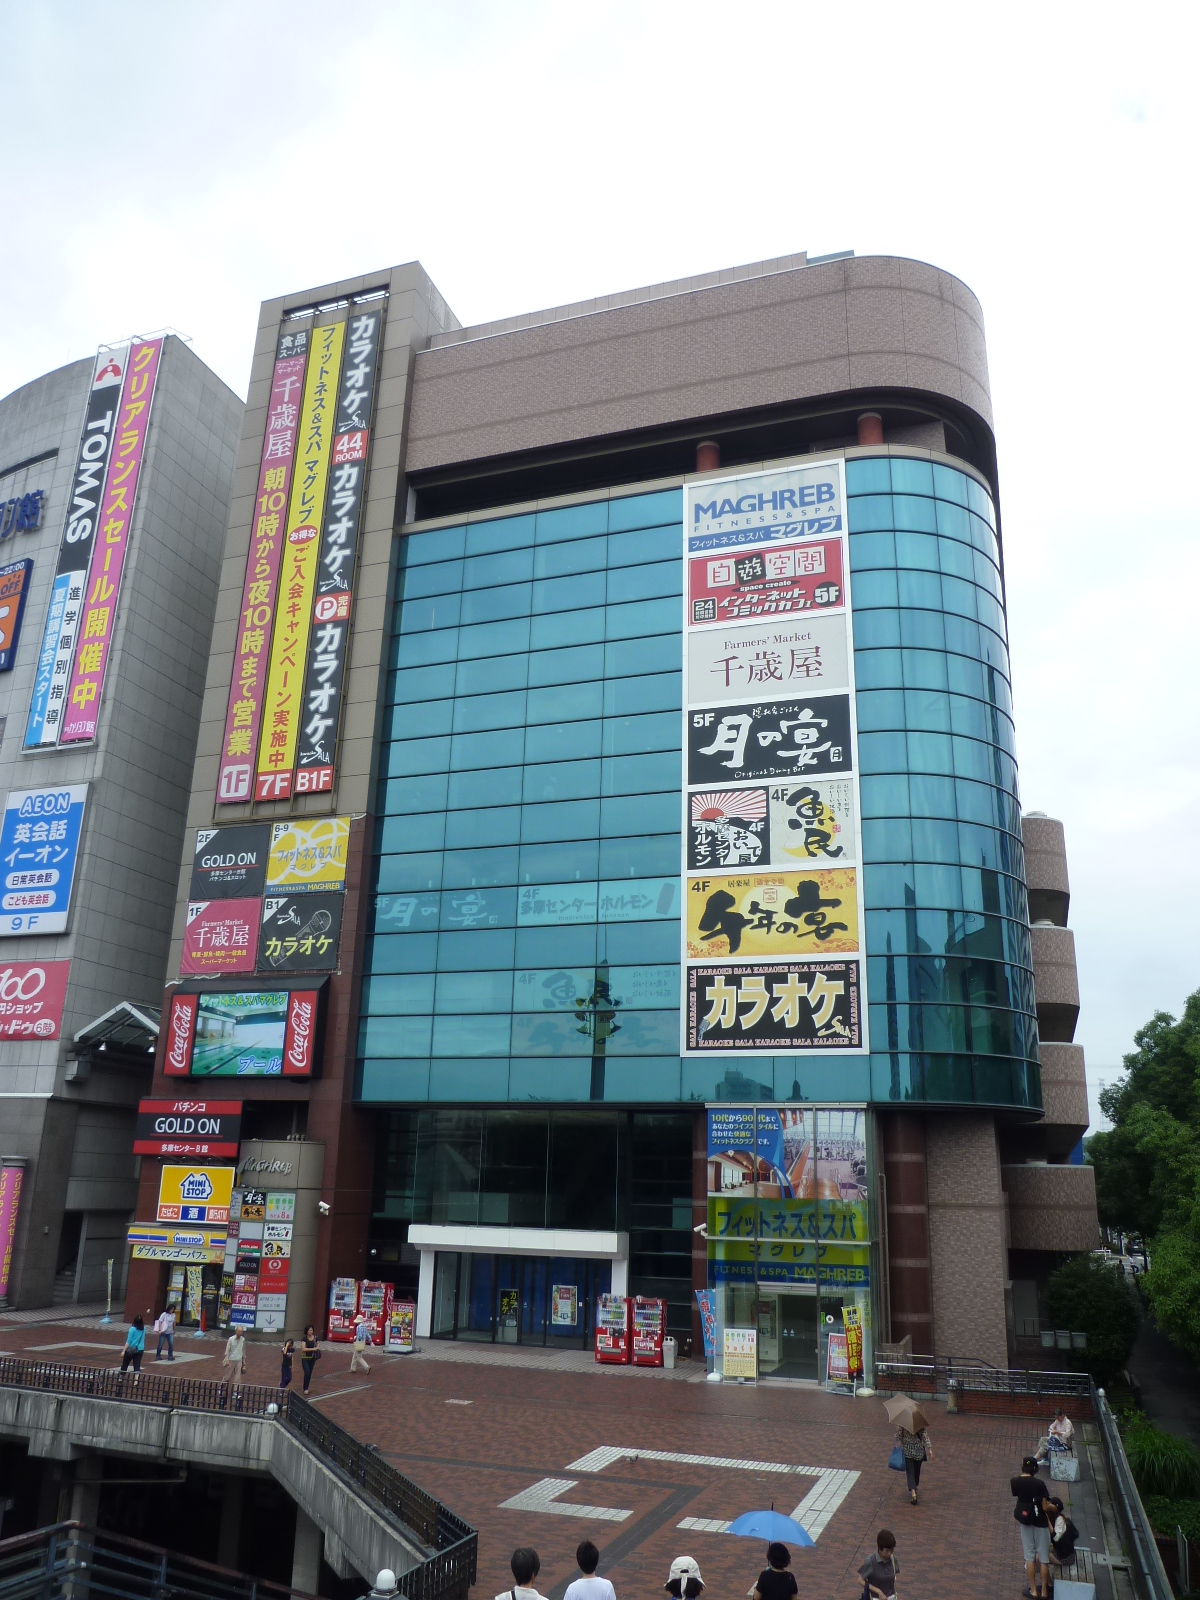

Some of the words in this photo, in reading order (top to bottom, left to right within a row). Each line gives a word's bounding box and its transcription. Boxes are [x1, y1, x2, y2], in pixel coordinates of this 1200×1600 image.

[281, 332, 306, 349] 食品
[279, 346, 306, 358] スーパー
[341, 314, 375, 415] カラオケ
[305, 327, 336, 455] フィットネス&スパ
[264, 376, 300, 460] 千歳屋
[336, 433, 362, 452] 44
[335, 450, 362, 462] ROOM
[66, 410, 113, 543] TOMAS
[298, 460, 320, 524] マグレブ
[694, 482, 836, 524] MAGHREB
[324, 464, 359, 573] カラオケ
[72, 346, 156, 710] クリアランスセール開催中
[289, 528, 317, 542] お得な
[691, 530, 765, 549] フィットネス&スパ
[770, 517, 838, 539] マグレブ
[709, 549, 824, 584] 自遊空間
[1, 579, 21, 595] OFF
[740, 584, 763, 592] space
[765, 580, 792, 588] create
[719, 588, 807, 607] インターネット
[814, 586, 839, 603] 5F
[228, 466, 287, 757] 朝10時から夜10時まで営業
[321, 600, 334, 617] P
[337, 596, 348, 617] 完備
[695, 601, 713, 611] 24
[726, 599, 815, 618] コミックカフェ
[773, 632, 812, 644] Market
[33, 587, 67, 728] 夏期講習会スタート
[46, 587, 81, 724] 進学個別指導
[268, 545, 310, 768] ご入会キャンペーン実施中
[710, 646, 823, 687] 千歳屋
[305, 624, 342, 745] カラオケ
[693, 712, 715, 728] 5F
[697, 708, 832, 768] 月の宴
[223, 769, 249, 794] 1F
[296, 770, 331, 791] B1F
[734, 768, 768, 778] Original
[259, 772, 290, 796] 7F
[21, 793, 69, 815] AEON
[771, 788, 788, 802] 4F
[275, 824, 289, 833] 6-9
[748, 822, 765, 832] 4F
[786, 786, 843, 858] 魚民
[13, 820, 68, 843] 英会話
[197, 834, 211, 843] 2F
[274, 834, 279, 842] F
[694, 822, 712, 866] ホルモン
[5, 846, 68, 867] イーオン
[202, 854, 236, 868] GOLD
[238, 852, 256, 865] ON
[12, 873, 53, 885] 日常英会話
[307, 882, 341, 891] MAGHREB
[691, 881, 710, 893] 4F
[8, 894, 50, 906] こども英会話
[523, 888, 540, 899] 4F
[266, 900, 279, 910] B1
[379, 893, 487, 927] 月の宴
[698, 880, 848, 954] 千年の宴
[193, 925, 249, 947] 千歳屋
[265, 935, 333, 957] カラオケ
[519, 973, 536, 984] 4F
[698, 967, 732, 976] KARAOKE
[734, 966, 752, 975] SALA
[753, 965, 788, 974] KARAOKE
[790, 964, 809, 973] SALA
[0, 968, 46, 1001] 100
[703, 972, 844, 1030] カラオケ
[36, 1022, 53, 1033] 6階
[698, 1039, 733, 1047] KARAOKE
[735, 1039, 753, 1047] SALA
[754, 1038, 791, 1046] KARAOKE
[792, 1038, 811, 1046] SALA
[237, 1055, 282, 1073] プール
[173, 1102, 206, 1111] パチンコ
[155, 1117, 194, 1134] GOLD
[198, 1118, 220, 1134] ON
[161, 1144, 208, 1153] 多摩センターB館
[186, 1187, 206, 1196] STOP
[187, 1179, 206, 1188] MINI
[160, 1207, 178, 1218] たばこ
[188, 1207, 200, 1219] 酒
[2, 1172, 23, 1285] クリアランスセール開催中
[717, 1211, 857, 1240] フィットネス&スパ
[136, 1246, 207, 1260] ダブルマンゴーパフェ
[793, 1266, 865, 1282] MAGHREB
